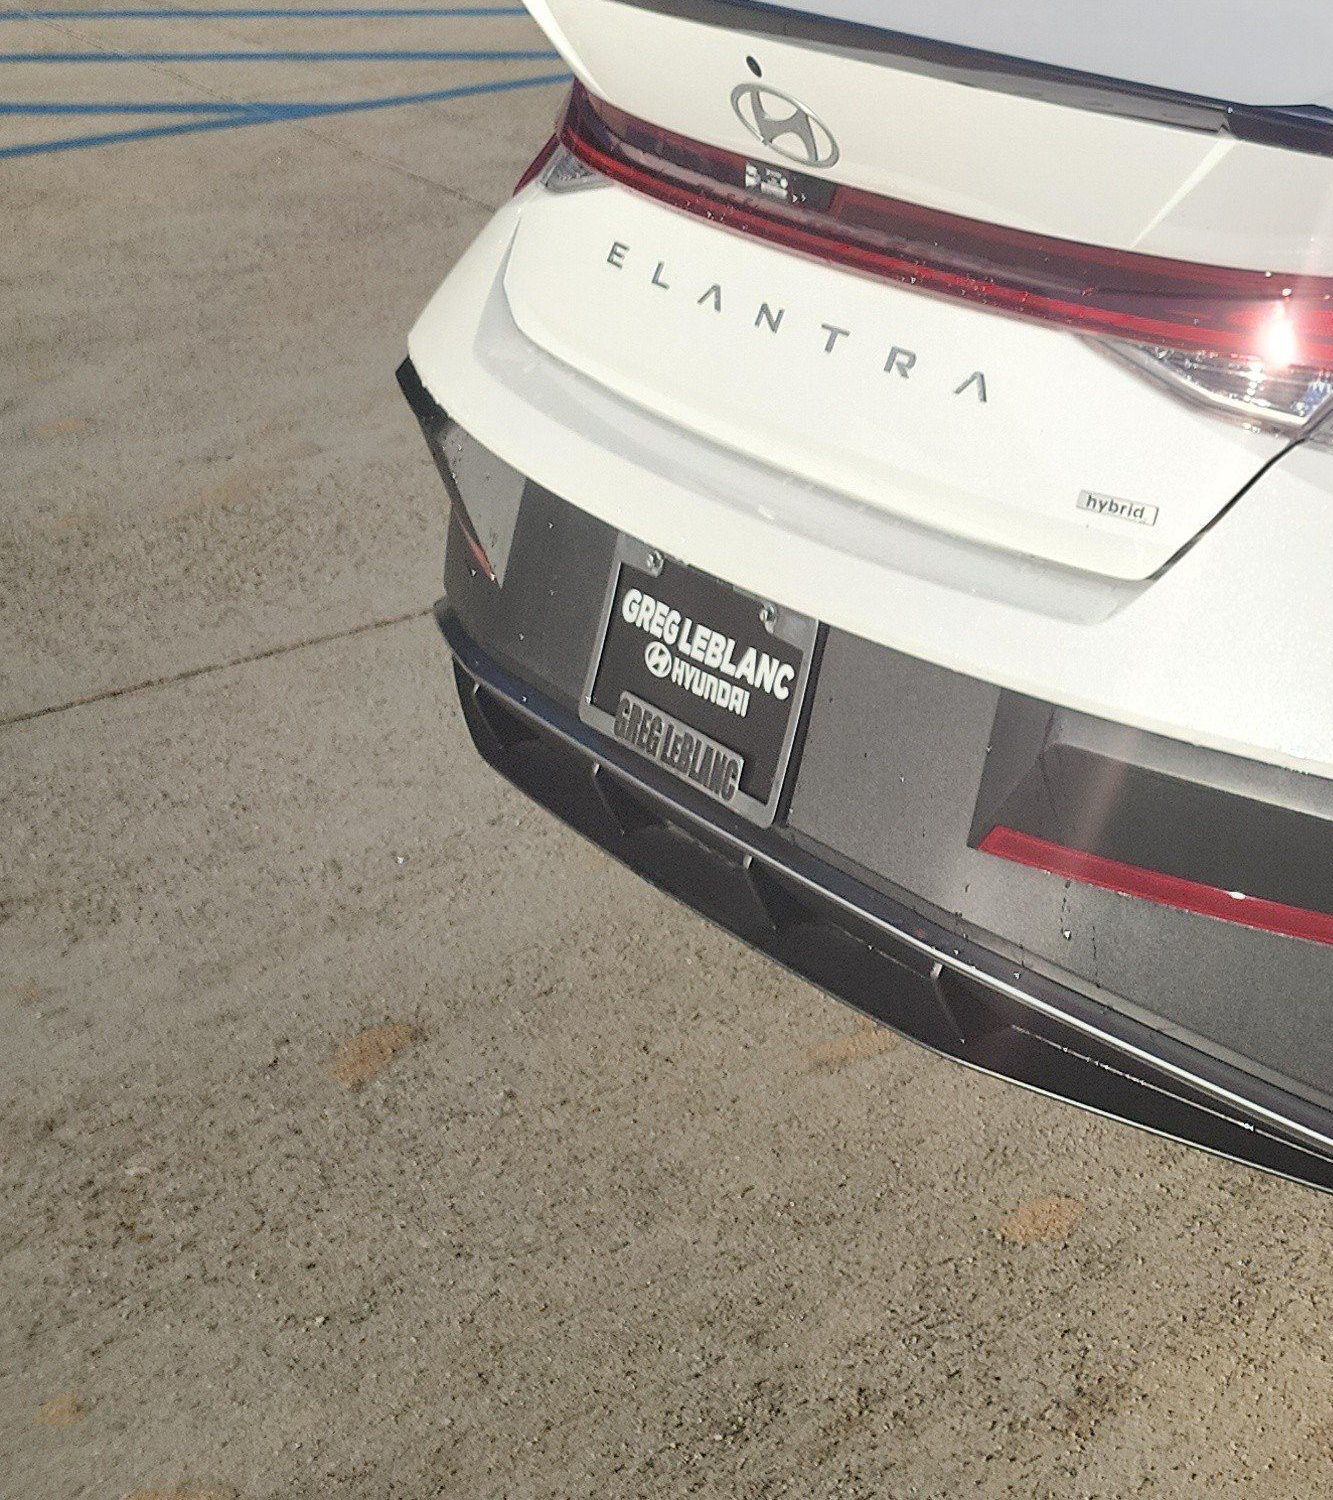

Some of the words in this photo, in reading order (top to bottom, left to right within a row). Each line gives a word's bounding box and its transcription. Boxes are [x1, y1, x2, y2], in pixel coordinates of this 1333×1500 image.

[607, 241, 988, 403] ELANTRA
[1086, 494, 1145, 519] hybrid
[621, 588, 681, 645] GREG
[677, 617, 795, 700] LEBLANC
[671, 657, 750, 718] HYUNDAI
[613, 697, 664, 758] GREG
